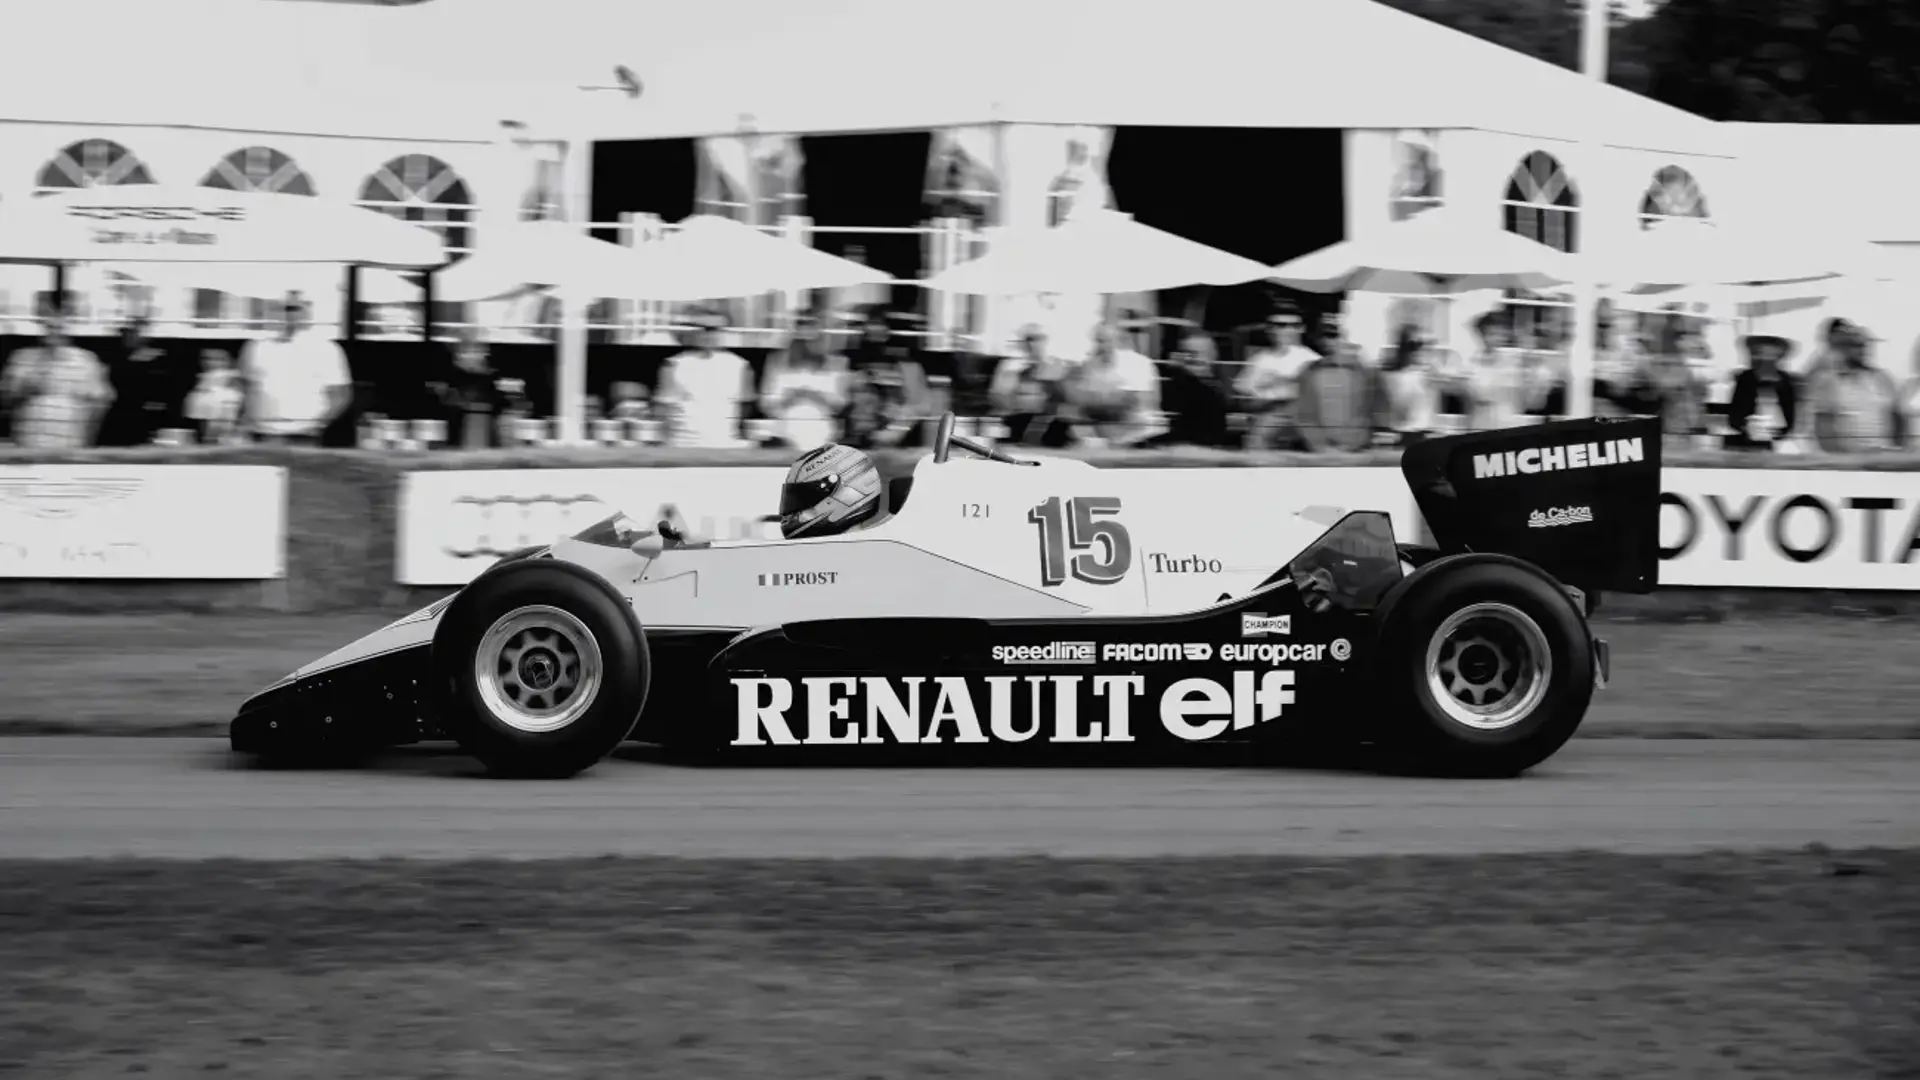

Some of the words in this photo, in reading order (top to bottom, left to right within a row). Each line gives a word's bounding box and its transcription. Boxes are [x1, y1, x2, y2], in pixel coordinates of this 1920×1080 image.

[1473, 437, 1643, 479] MICHELIN
[1659, 492, 1920, 563] OYOT
[1027, 496, 1132, 588] 15
[1149, 553, 1223, 573] Turbo
[783, 571, 838, 585] PROST
[1244, 620, 1289, 629] CHAMPION
[992, 641, 1092, 664] speedline
[1102, 643, 1182, 661] FACOM
[1219, 643, 1327, 665] europcar
[730, 676, 1145, 745] RENAULT
[1160, 670, 1295, 741] elf
